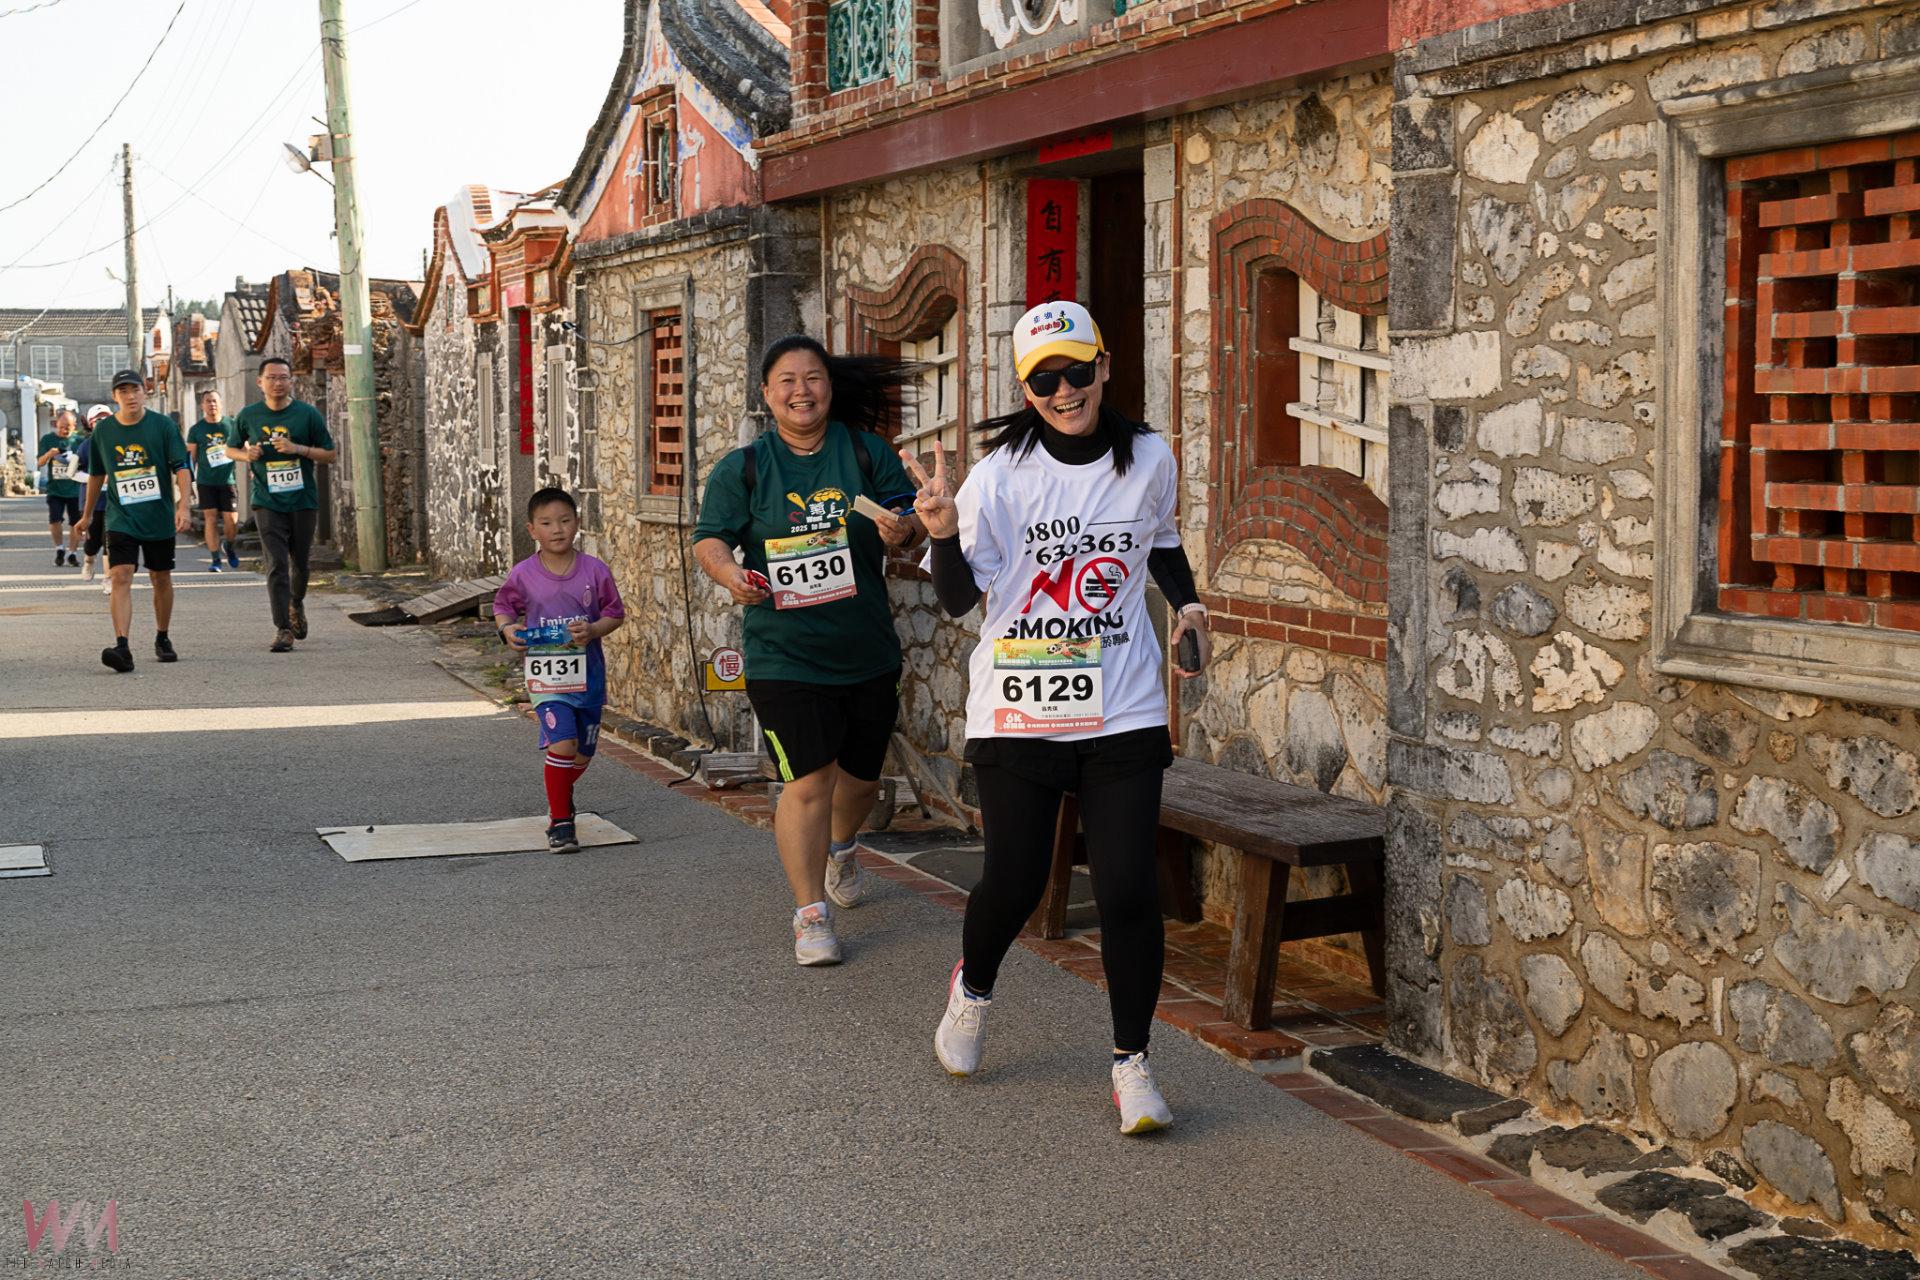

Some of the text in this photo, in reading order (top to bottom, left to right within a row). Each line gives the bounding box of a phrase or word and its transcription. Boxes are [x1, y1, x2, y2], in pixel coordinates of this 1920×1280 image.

[122, 479, 155, 494] 1169
[271, 470, 300, 483] 1107
[776, 555, 846, 586] 6130
[530, 658, 580, 676] 6131
[719, 654, 741, 678] 慢
[1002, 674, 1094, 703] 6129
